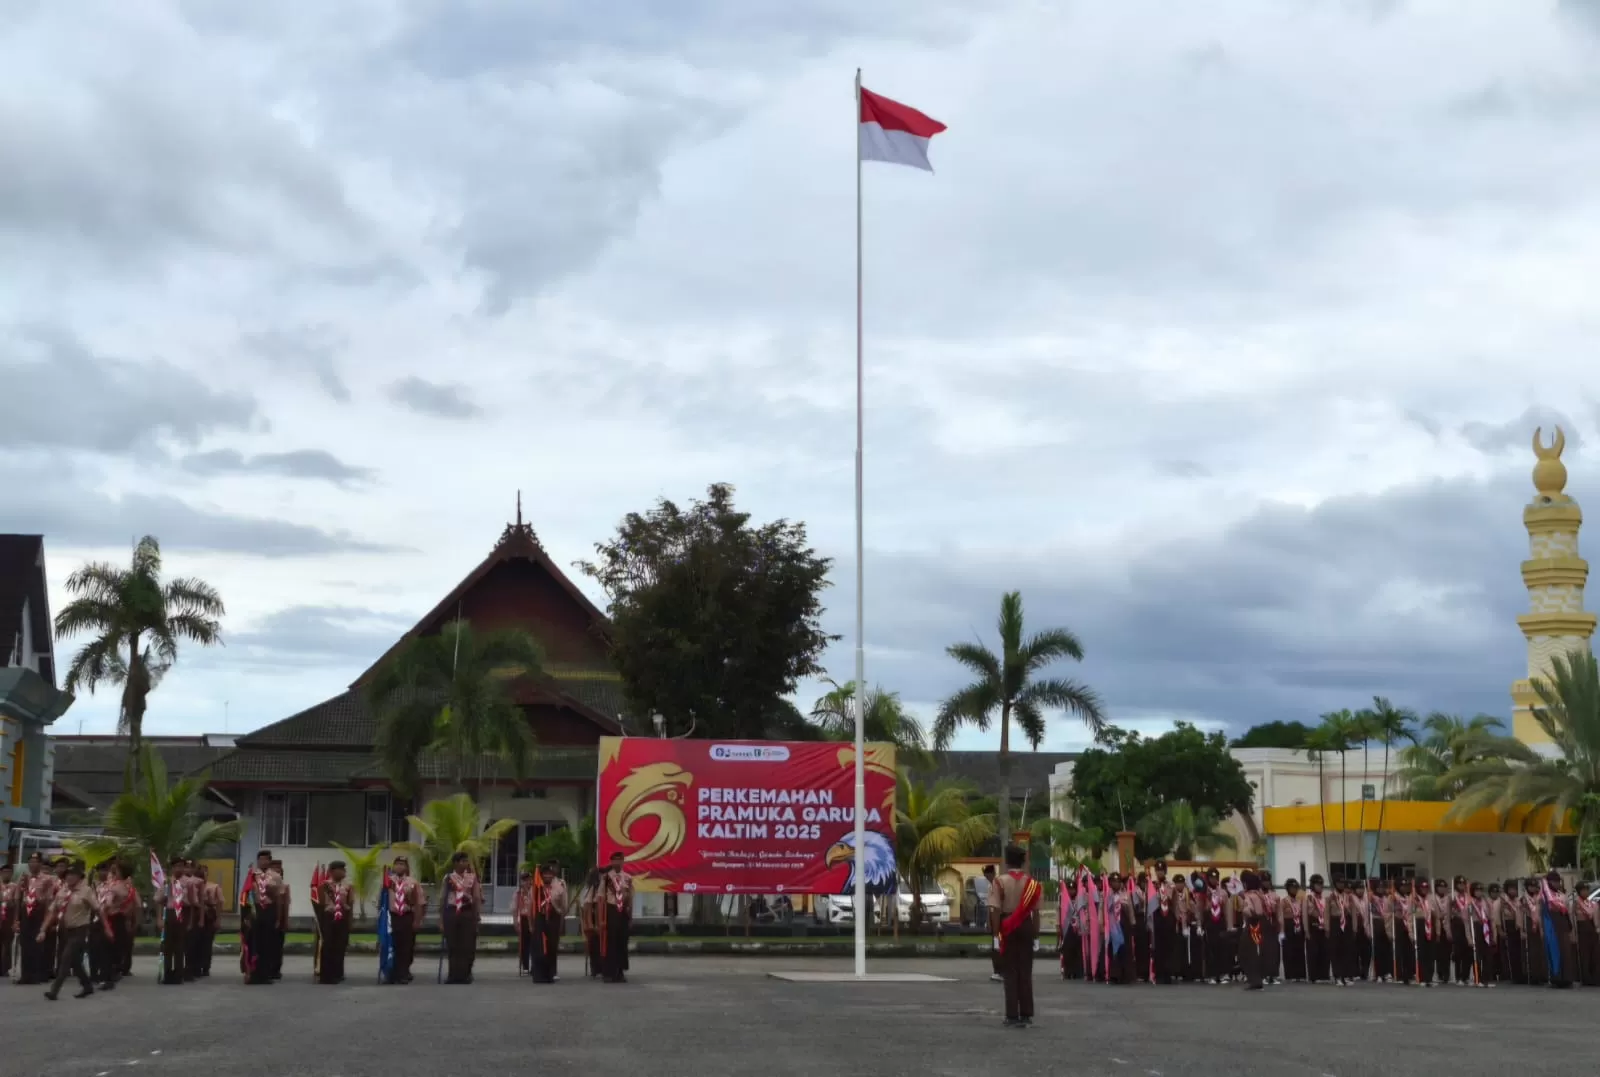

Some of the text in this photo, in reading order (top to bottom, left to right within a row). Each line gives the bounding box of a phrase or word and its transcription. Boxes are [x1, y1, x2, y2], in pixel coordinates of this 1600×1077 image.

[698, 788, 832, 804] PERKEMAHAN
[698, 805, 796, 821] PRAMUKA
[698, 823, 821, 839] KALTIM 2025
